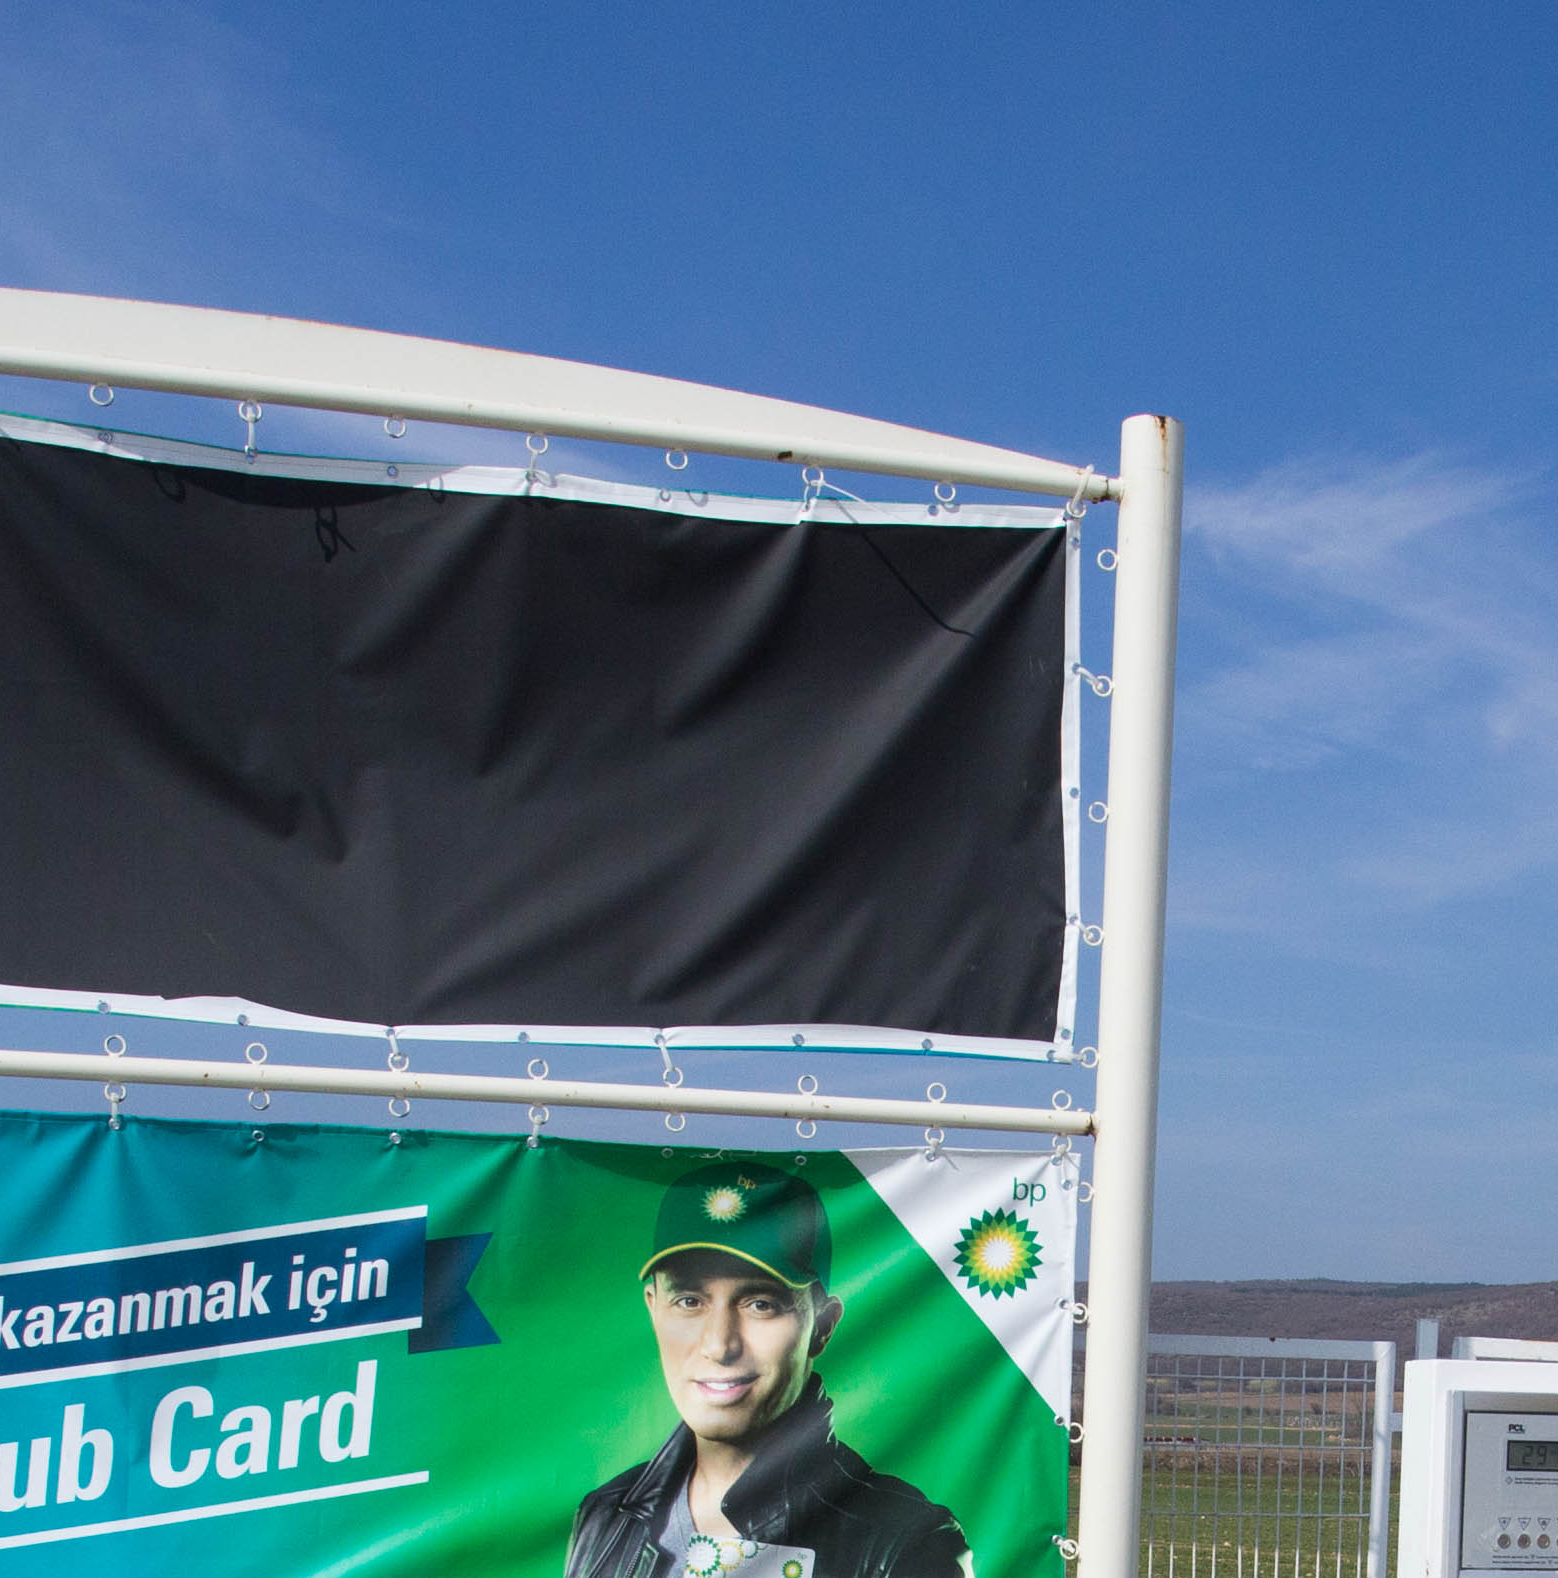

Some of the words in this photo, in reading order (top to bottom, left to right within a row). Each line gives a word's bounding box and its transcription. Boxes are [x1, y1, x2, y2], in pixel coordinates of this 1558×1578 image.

[1012, 1177, 1047, 1207] bp
[288, 1247, 389, 1323] için
[149, 1359, 378, 1489] Card
